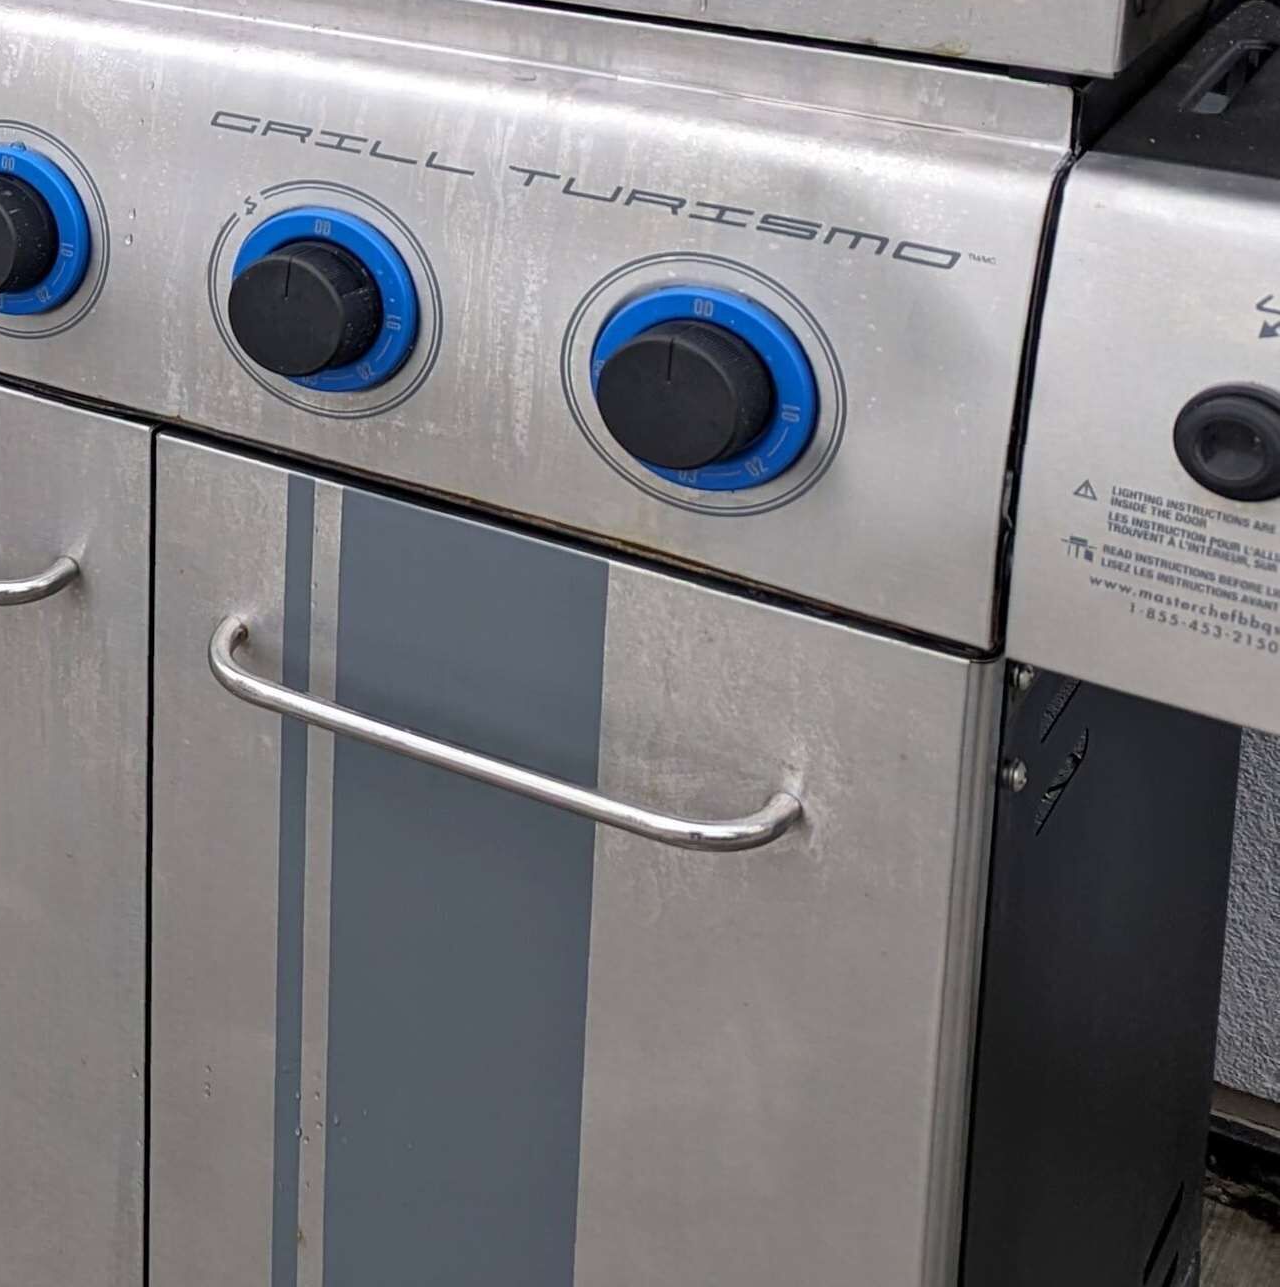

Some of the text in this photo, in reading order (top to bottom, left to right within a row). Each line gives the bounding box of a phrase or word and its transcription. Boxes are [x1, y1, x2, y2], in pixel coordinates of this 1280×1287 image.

[210, 110, 475, 176] GRILL
[508, 165, 962, 270] TURISMO
[1108, 511, 1128, 524] LES
[1131, 517, 1207, 543] INSTRUCTION
[1209, 536, 1242, 553] POUR
[1110, 497, 1208, 529] INSIDE THE DOOR
[1112, 486, 1277, 534] LIGHTING INSTRUCTIONS ARE
[1103, 544, 1133, 560] READ
[1135, 553, 1217, 581] INSTRUCTIONS
[1218, 574, 1264, 595] BEFORE
[1107, 521, 1165, 544] TROUVENT
[1254, 558, 1278, 572] SUR
[1101, 557, 1279, 612] LISEZ LES INSTRUCTIONS AVANT
[1129, 602, 1279, 654] 1-855-453-2150
